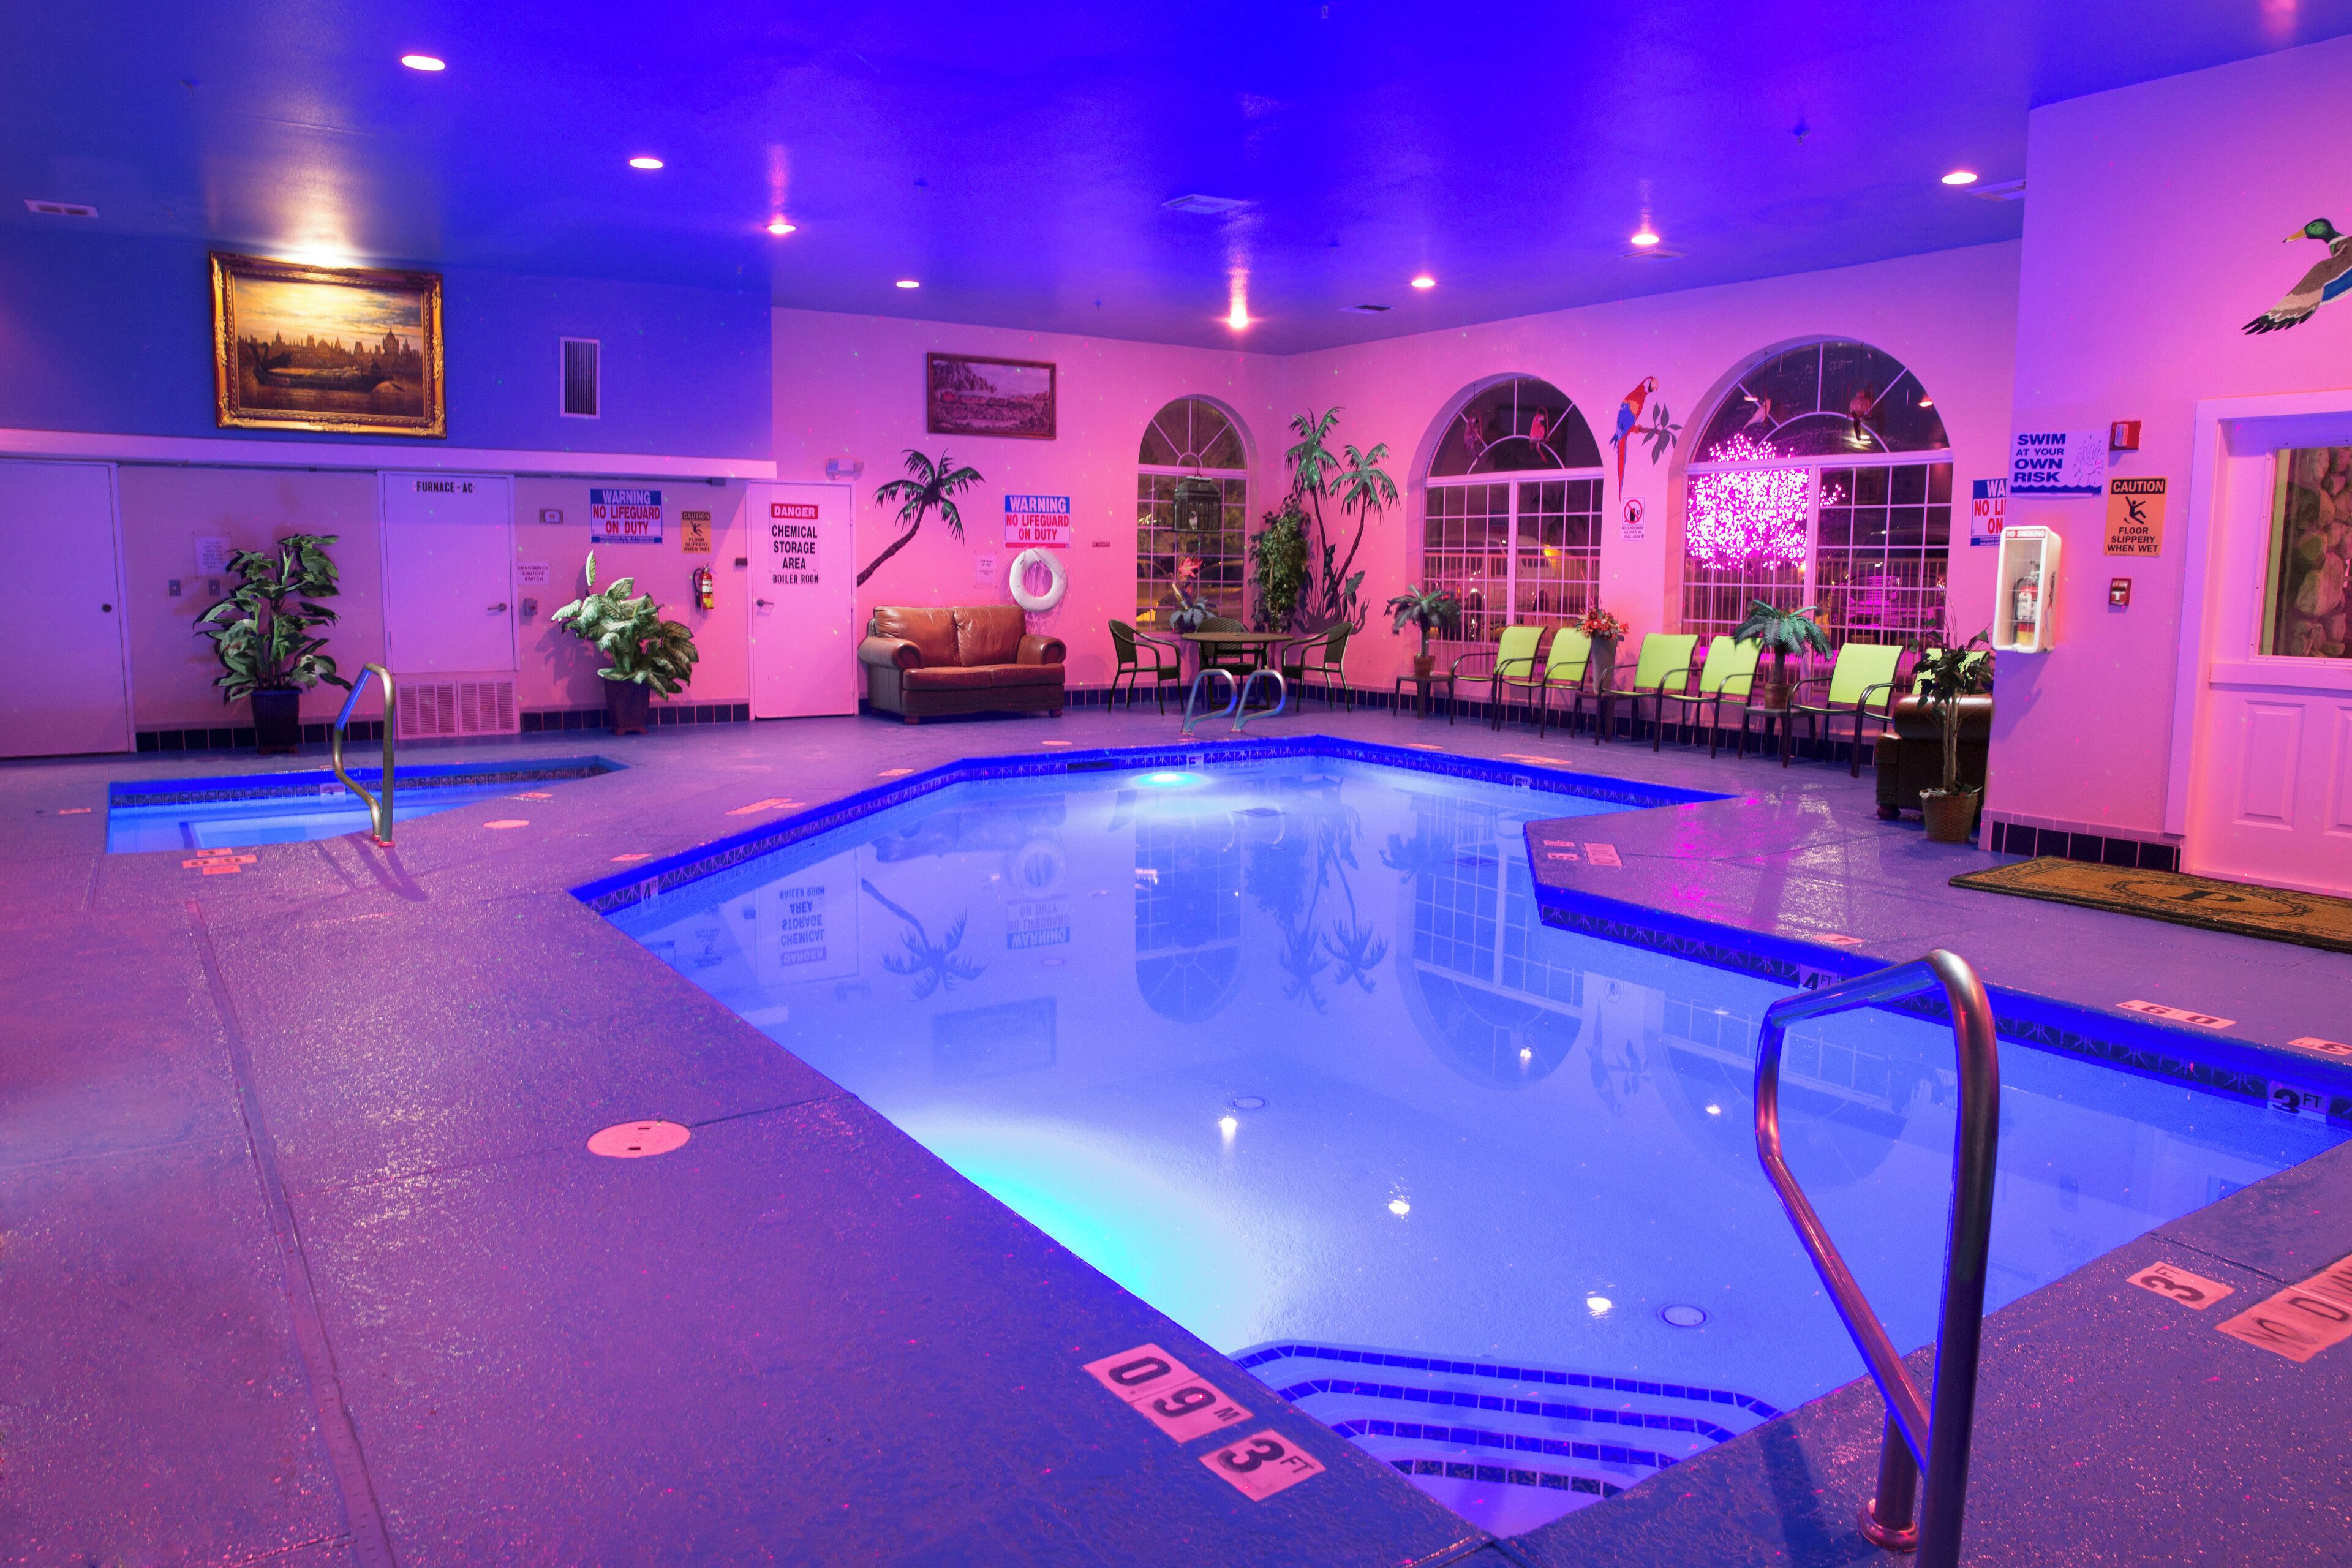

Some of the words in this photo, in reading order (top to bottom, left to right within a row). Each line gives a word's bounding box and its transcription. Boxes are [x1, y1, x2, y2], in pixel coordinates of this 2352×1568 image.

[2017, 433, 2066, 445] SWIM
[2015, 458, 2063, 469] OWN
[2013, 472, 2060, 483] RISK
[417, 481, 455, 493] FURNACE
[462, 483, 473, 493] AC
[2113, 480, 2164, 492] CAUTION
[602, 489, 651, 504] WARNING
[774, 505, 815, 517] DANGER
[1009, 496, 1066, 513] WARNING
[1974, 500, 1989, 516] NO
[593, 505, 606, 519] NO
[611, 506, 660, 520] LIFEGUARD
[1006, 514, 1018, 526] NO
[1022, 514, 1069, 527] LIFEGUARD
[1988, 518, 2003, 534] ON
[605, 521, 619, 534] ON
[624, 521, 649, 534] DUTY
[772, 524, 818, 538] CHEMICAL
[1019, 528, 1030, 540] ON
[1035, 529, 1057, 540] DUTY
[774, 541, 815, 554] STORAGE
[782, 557, 806, 570] AREA
[773, 574, 798, 584] BOILER
[801, 574, 819, 584] ROOM
[643, 883, 652, 900] 4
[1802, 972, 1819, 990] 4
[1820, 974, 1833, 986] FT
[2272, 1088, 2301, 1114] 3
[2302, 1093, 2323, 1108] FT
[2154, 1266, 2180, 1279] FT
[2140, 1275, 2206, 1302] 3
[1213, 1406, 1241, 1422] M
[1216, 1438, 1286, 1473] 3
[1280, 1455, 1316, 1474] FT
